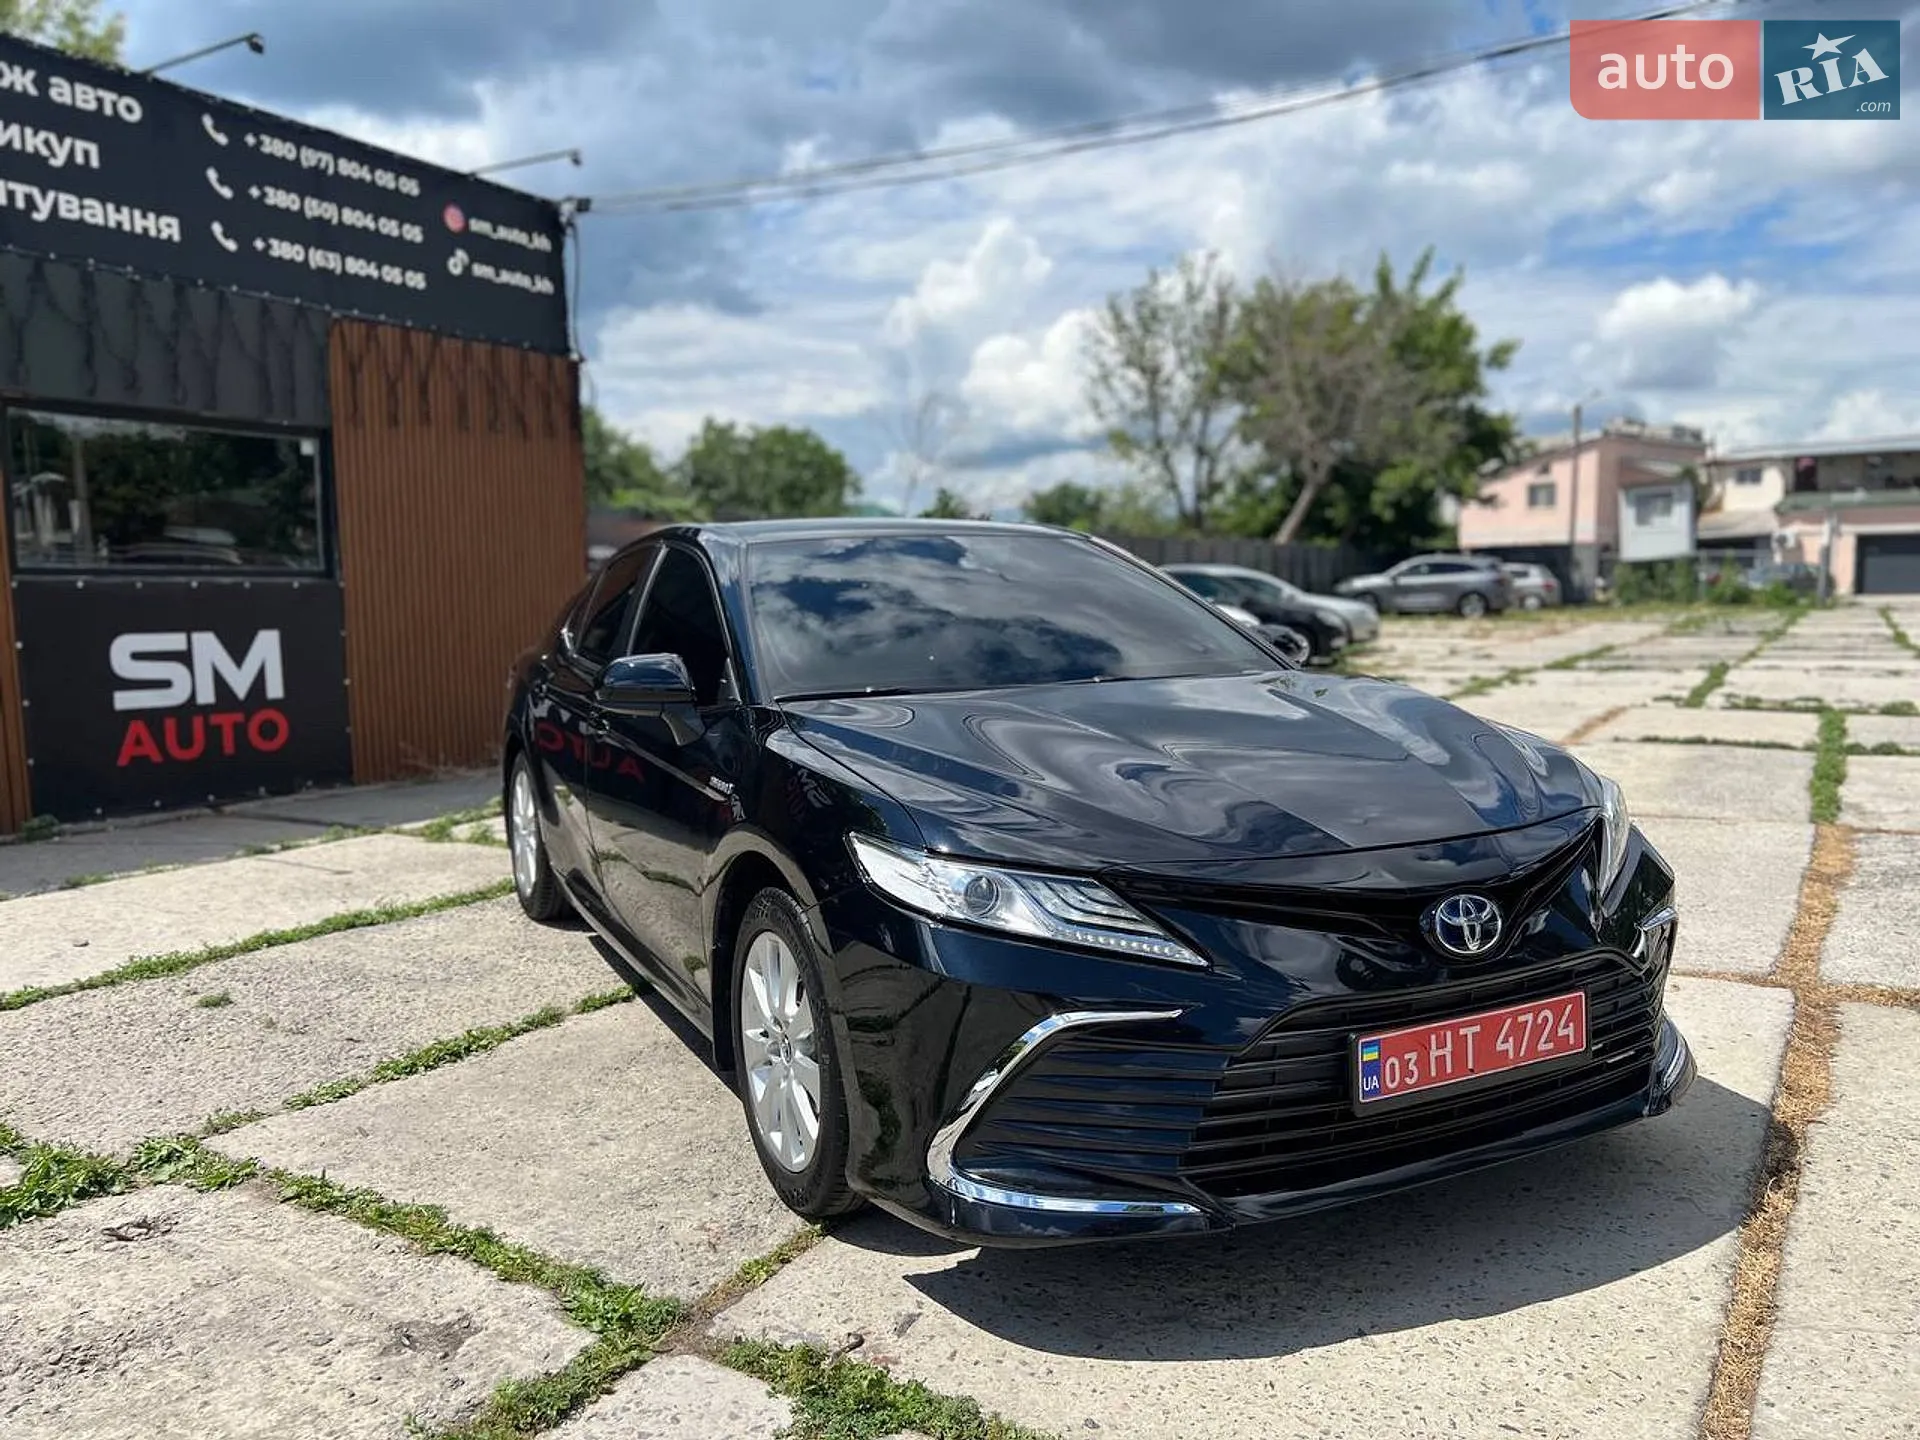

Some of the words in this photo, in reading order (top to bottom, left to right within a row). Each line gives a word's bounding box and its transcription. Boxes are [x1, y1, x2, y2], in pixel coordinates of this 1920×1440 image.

[48, 75, 143, 123] авто
[258, 133, 297, 162] 380
[337, 157, 373, 184] 804
[263, 185, 301, 212] 380
[341, 206, 377, 232] 804
[267, 237, 305, 263] 380
[344, 255, 380, 280] 804
[109, 629, 285, 712] SM
[116, 707, 290, 768] AUTO
[1384, 1052, 1419, 1089] 03
[1495, 1004, 1575, 1060] 4724
[1363, 1076, 1379, 1091] UA
